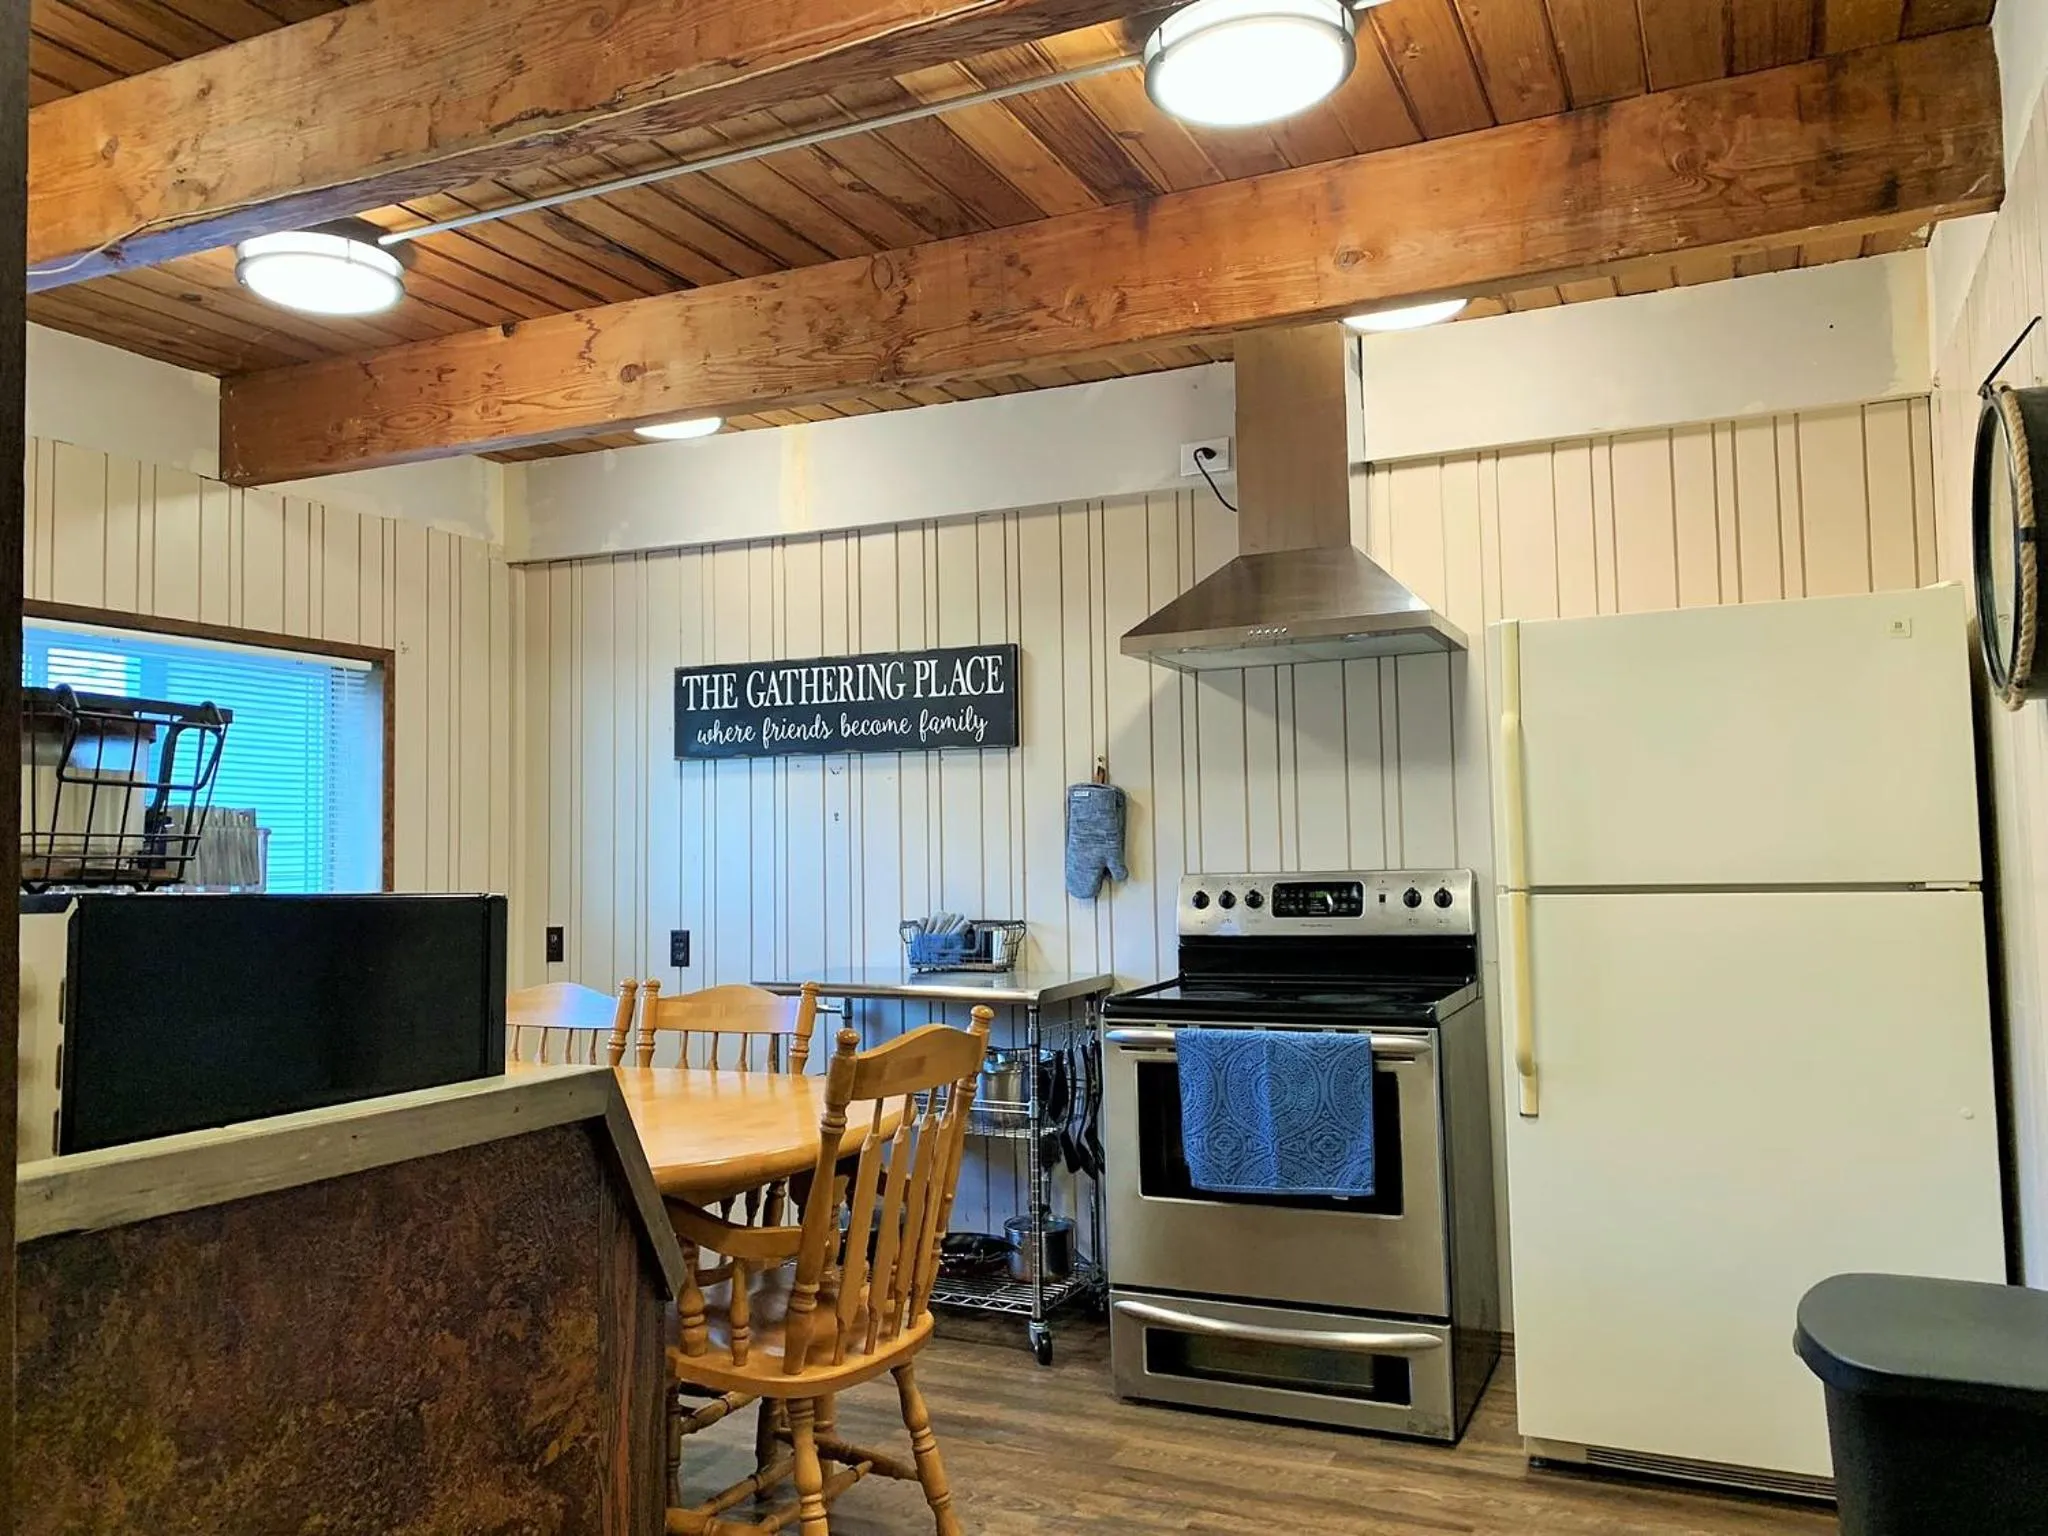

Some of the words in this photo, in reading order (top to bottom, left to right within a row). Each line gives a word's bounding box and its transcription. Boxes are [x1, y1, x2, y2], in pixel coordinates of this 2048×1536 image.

[682, 673, 738, 711] THE
[746, 661, 906, 709] GATHERING
[913, 655, 1004, 698] PLACE
[697, 719, 757, 746] where
[762, 714, 833, 750] friends
[840, 712, 912, 739] become
[919, 705, 988, 743] family
